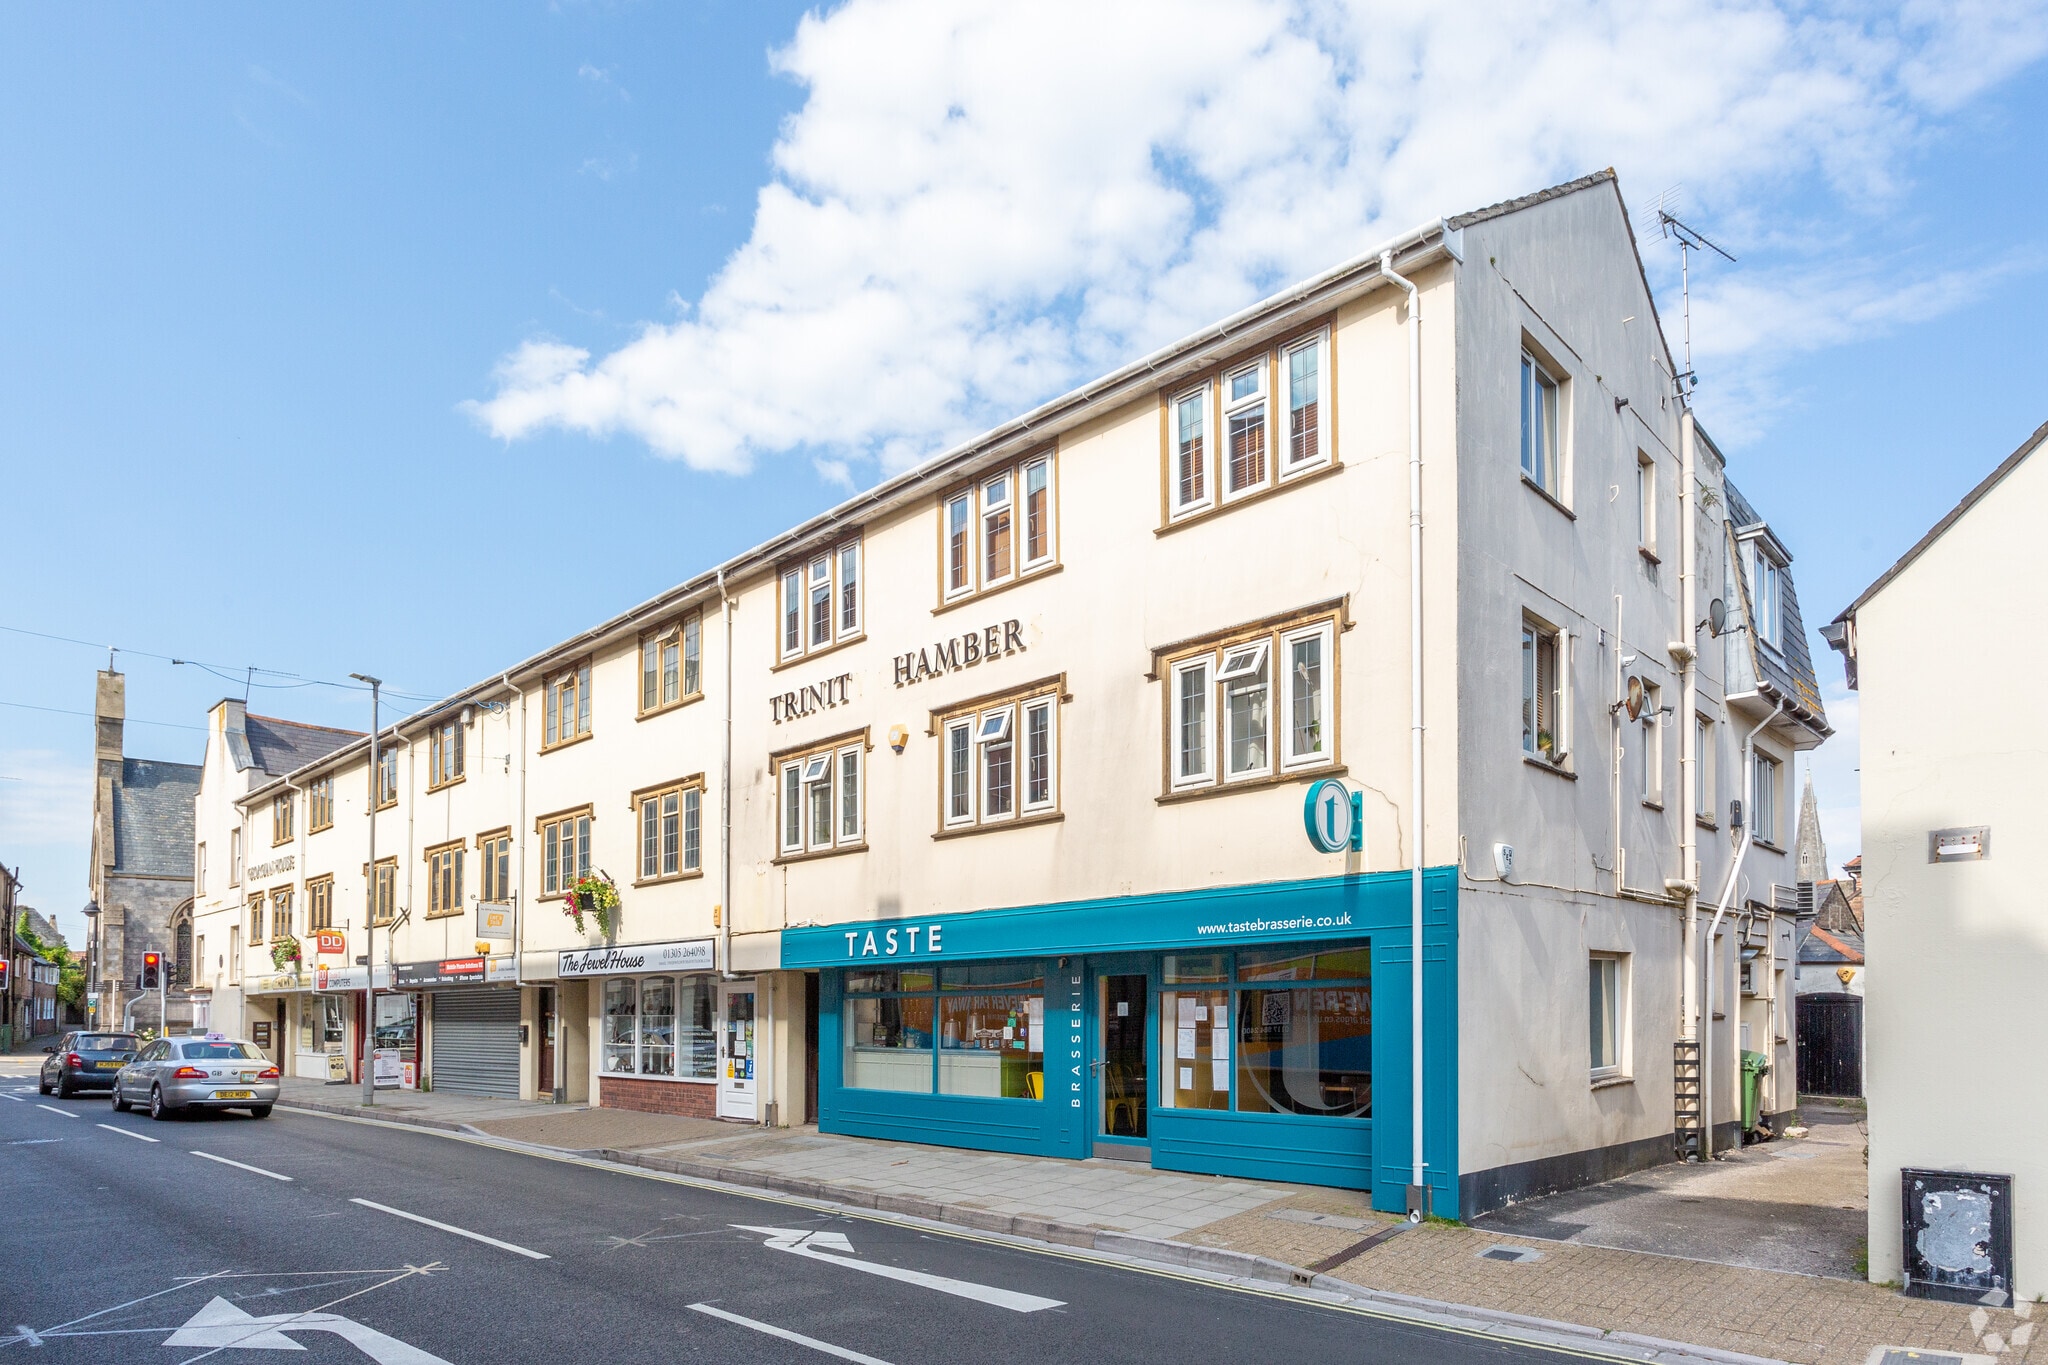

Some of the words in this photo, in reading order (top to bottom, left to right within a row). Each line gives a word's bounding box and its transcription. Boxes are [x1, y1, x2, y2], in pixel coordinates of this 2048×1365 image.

[1197, 911, 1352, 935] www.tastebrasserie.co.uk
[321, 935, 342, 947] DD
[844, 925, 942, 957] TASTE
[562, 954, 579, 972] The
[579, 951, 611, 973] Jewel
[610, 950, 645, 969] House
[662, 947, 681, 959] 01305
[1071, 975, 1081, 1108] BRASSERIE
